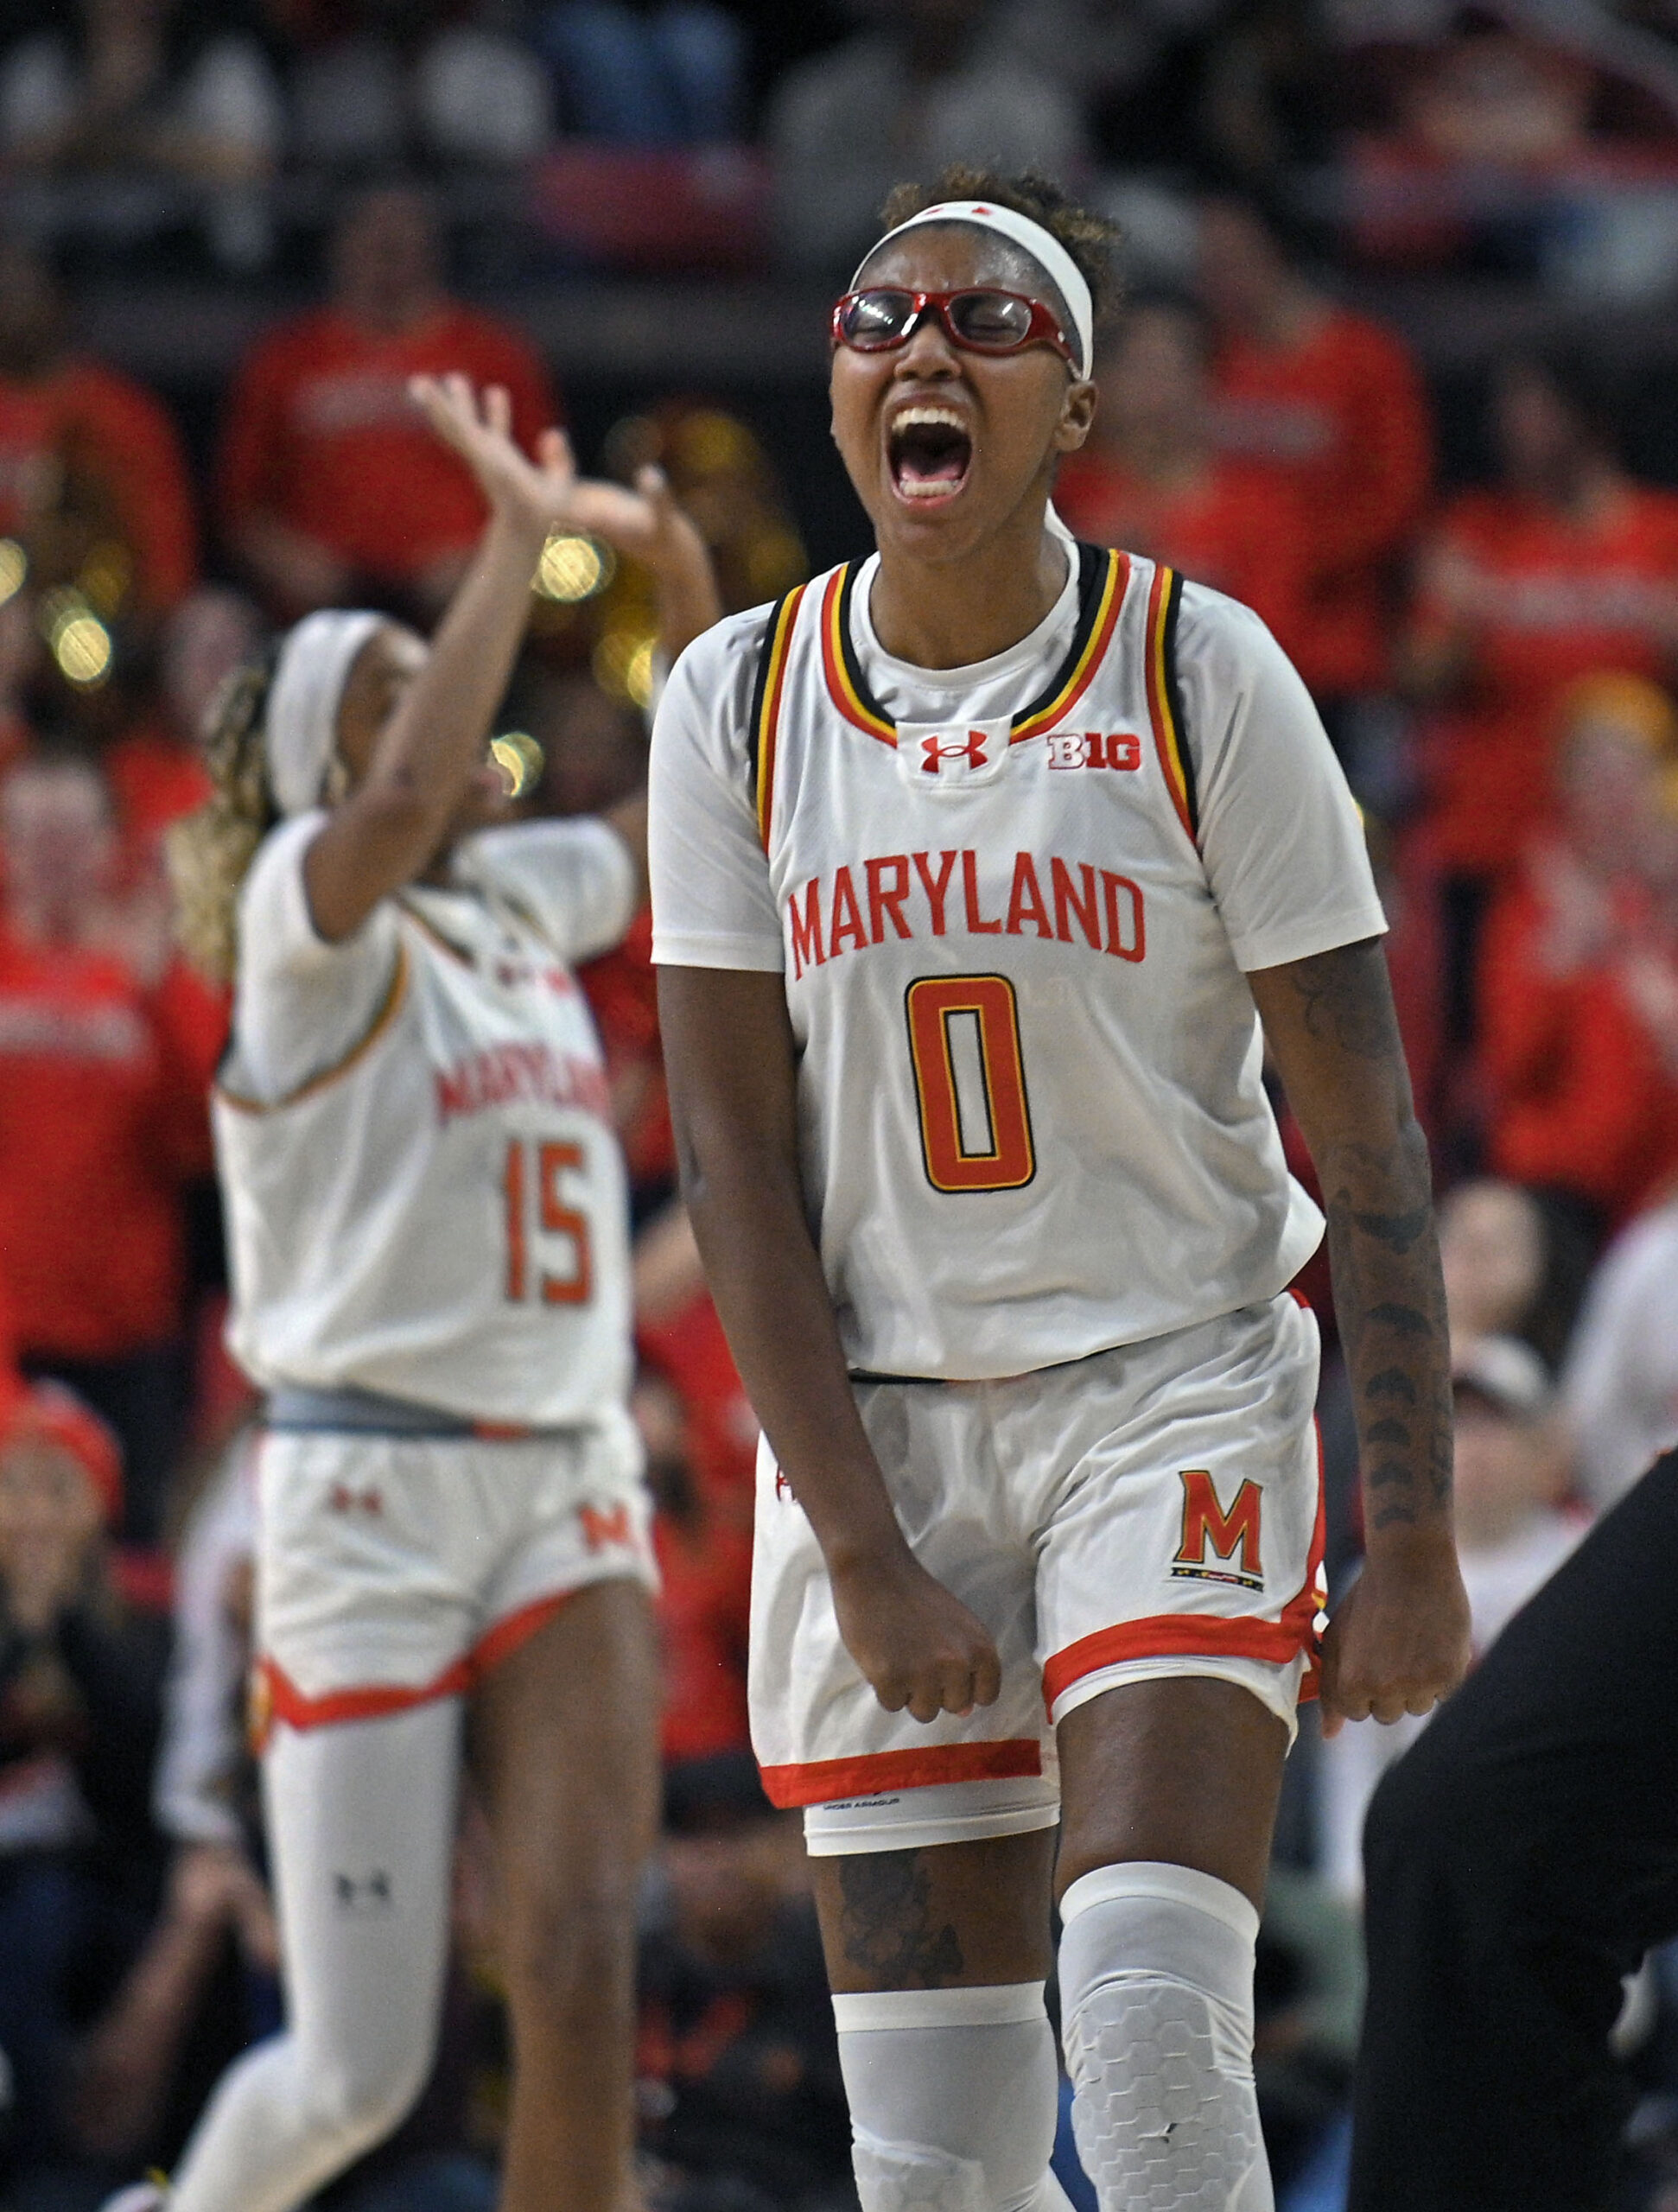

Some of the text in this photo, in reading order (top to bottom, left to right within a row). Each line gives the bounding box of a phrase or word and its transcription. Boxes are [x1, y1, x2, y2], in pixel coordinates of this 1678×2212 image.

[788, 849, 1146, 981] MARYLAND
[904, 973, 1036, 1194] 0
[501, 1136, 593, 1304] 15
[1173, 1470, 1263, 1577] M
